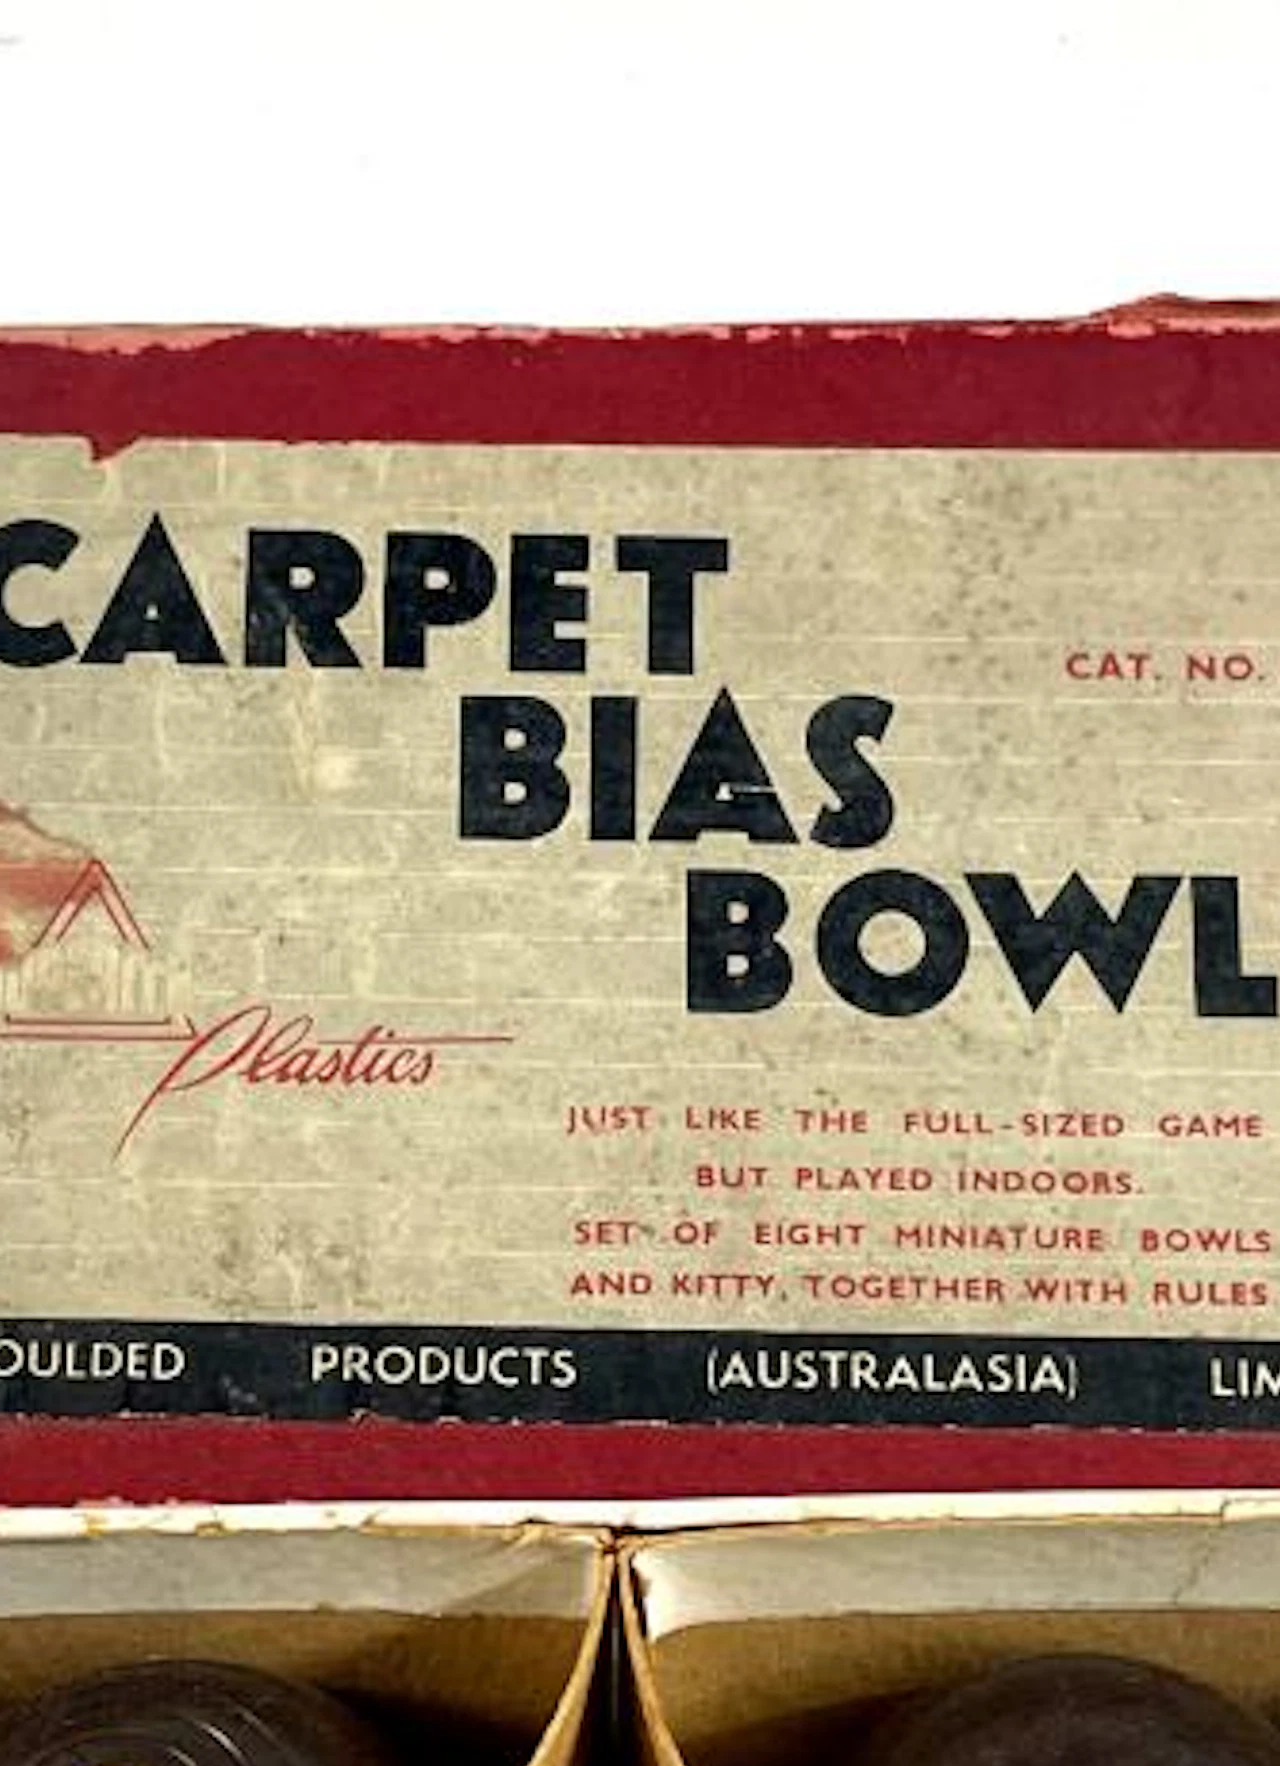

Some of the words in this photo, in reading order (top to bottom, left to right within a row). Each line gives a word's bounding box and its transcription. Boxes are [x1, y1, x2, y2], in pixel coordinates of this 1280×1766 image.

[1065, 652, 1163, 681] CAT.
[1186, 652, 1266, 682] NO.
[457, 685, 897, 849] BIAS
[113, 1005, 513, 1164] Plastics
[566, 1106, 650, 1132] JUST
[685, 1107, 761, 1132] LIKE
[794, 1110, 869, 1134] THE
[904, 1112, 1125, 1138] FULL-SIZED
[1158, 1114, 1263, 1139] GAME
[696, 1166, 768, 1190] BUT
[796, 1168, 933, 1192] PLAYED
[957, 1170, 1144, 1196] INDOORS.
[574, 1220, 638, 1246] SET
[674, 1221, 720, 1246] OF
[755, 1222, 865, 1247] EIGHT
[896, 1224, 1103, 1252] MINIATURE
[1141, 1229, 1273, 1255] BOWLS
[570, 1272, 653, 1298] AND
[672, 1272, 788, 1301] KITTY,
[801, 1275, 1004, 1304] TOGETHER
[1025, 1279, 1128, 1306] WITH
[1152, 1281, 1270, 1308] RULES
[310, 1341, 580, 1392] PRODUCTS
[703, 1350, 1081, 1399] (AUSTRALASIA)
